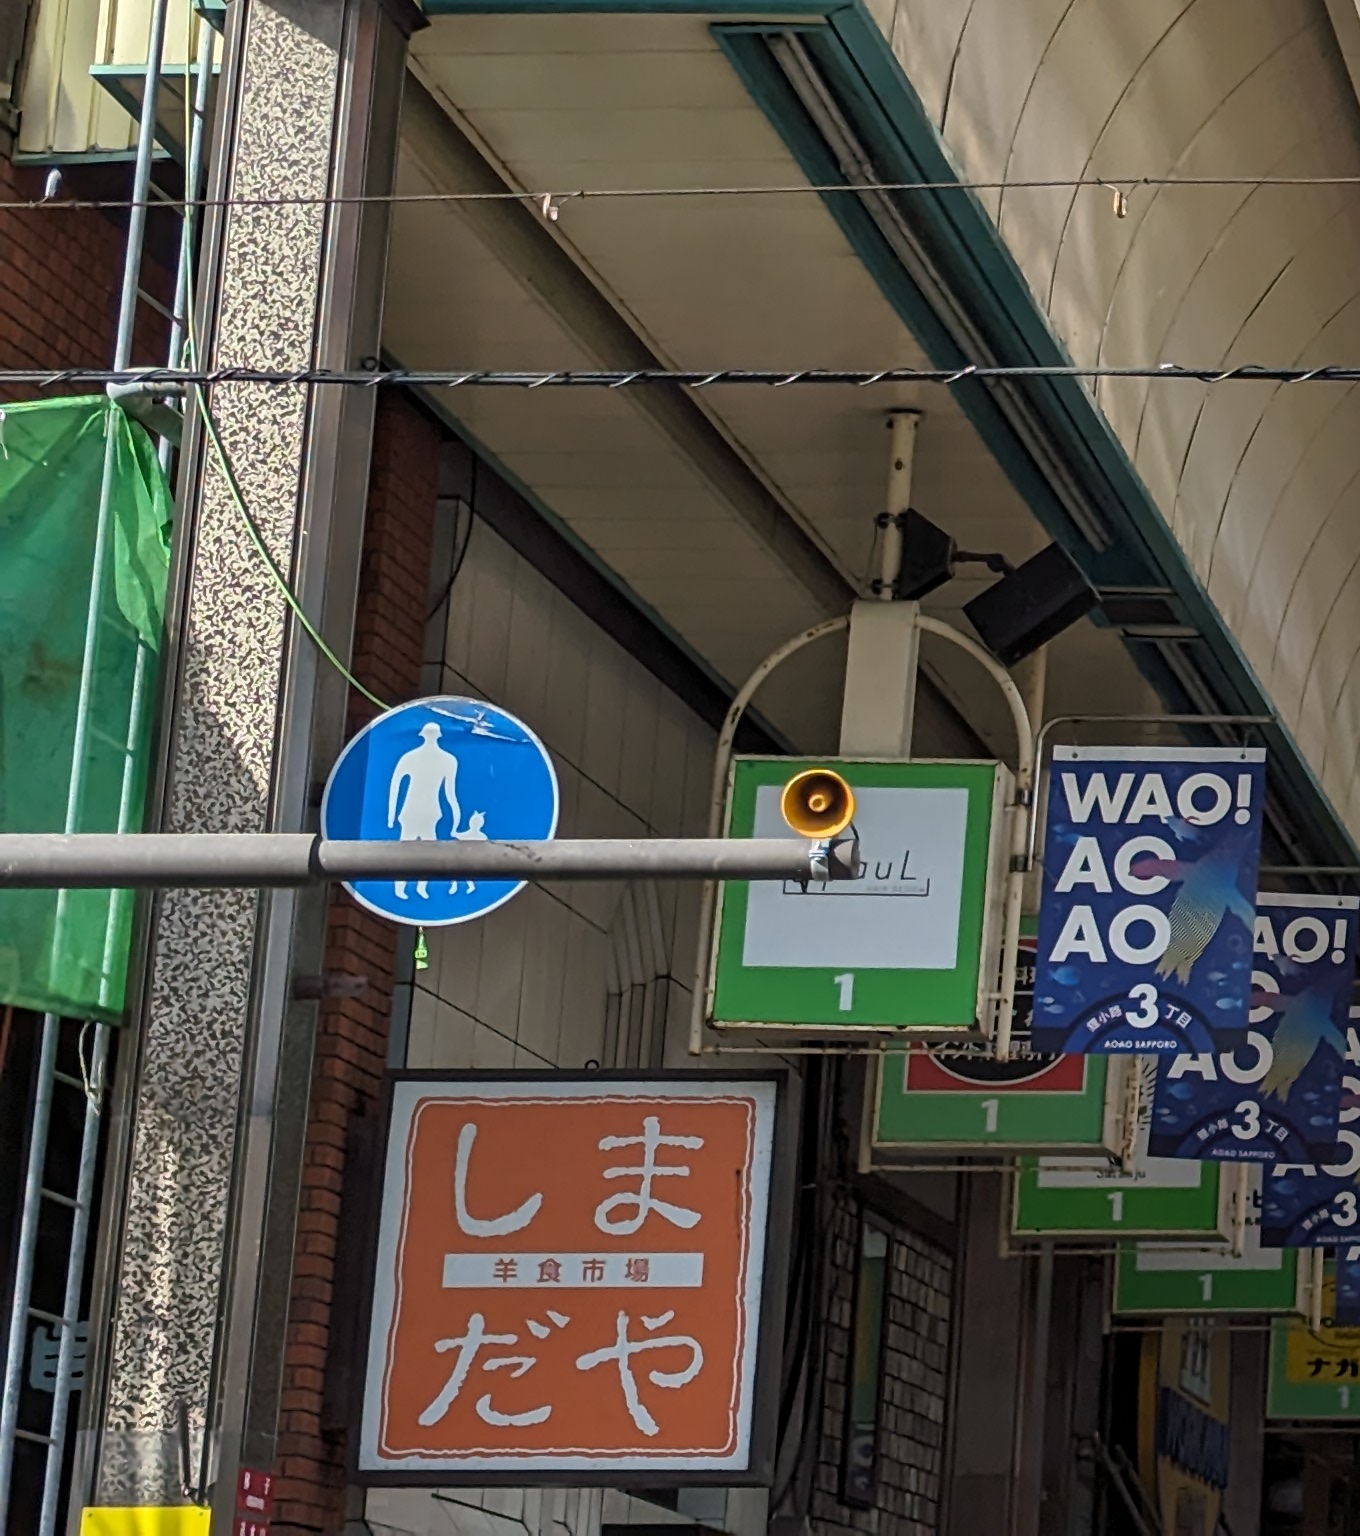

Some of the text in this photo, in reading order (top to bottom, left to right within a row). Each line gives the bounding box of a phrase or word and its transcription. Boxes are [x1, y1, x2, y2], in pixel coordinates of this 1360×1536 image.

[1061, 772, 1252, 826] WAO!
[1048, 904, 1171, 964] AO
[834, 973, 854, 1011] 1
[1125, 983, 1159, 1029] 3
[981, 1098, 999, 1133] 1
[1231, 1100, 1261, 1140] 3
[1107, 1191, 1124, 1221] 1
[493, 1258, 650, 1284] 羊食市場
[1199, 1273, 1213, 1301] 1
[1337, 1385, 1350, 1408] 1
